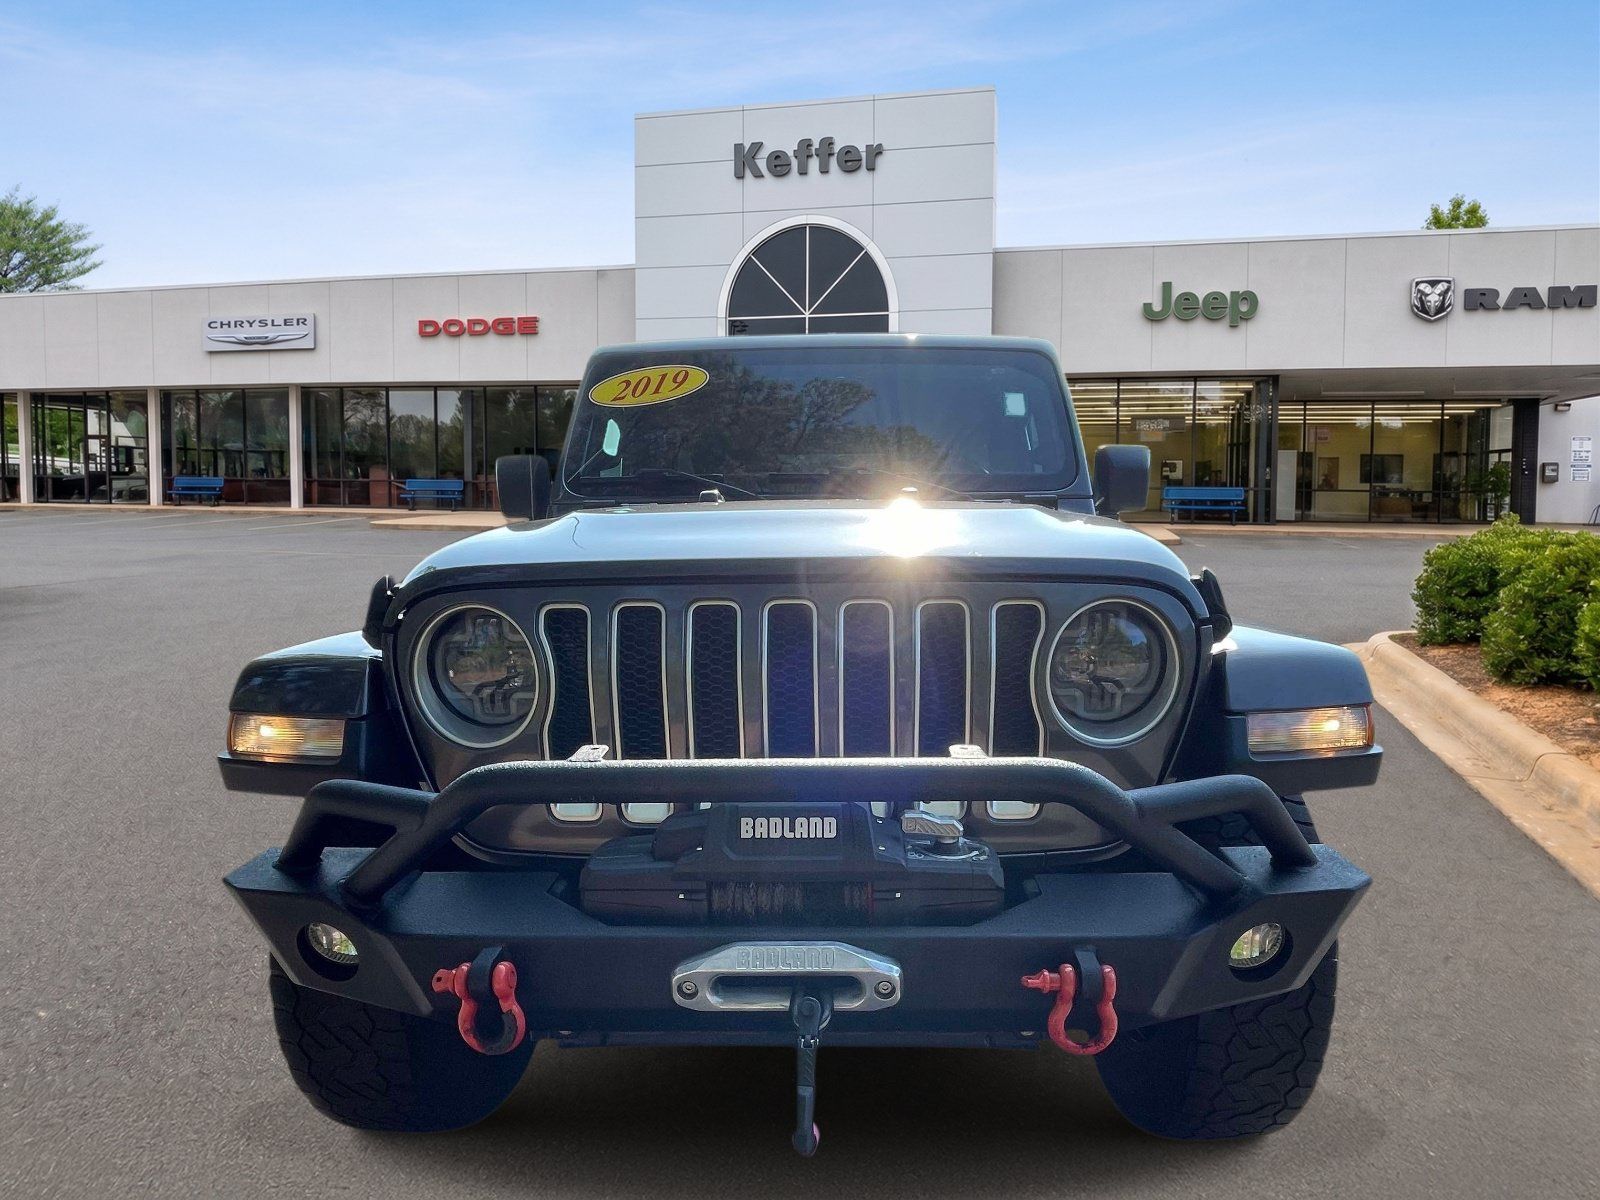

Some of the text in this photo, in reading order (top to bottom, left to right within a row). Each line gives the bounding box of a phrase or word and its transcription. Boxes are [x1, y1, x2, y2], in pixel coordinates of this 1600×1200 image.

[734, 137, 883, 178] Keffer
[1143, 281, 1259, 327] Jeep
[1464, 285, 1598, 310] RAM
[207, 317, 308, 329] CHRYSLER
[418, 316, 539, 337] DODGE
[610, 369, 690, 402] 2019
[740, 817, 837, 839] BADLAND
[736, 947, 835, 970] BADLAND
